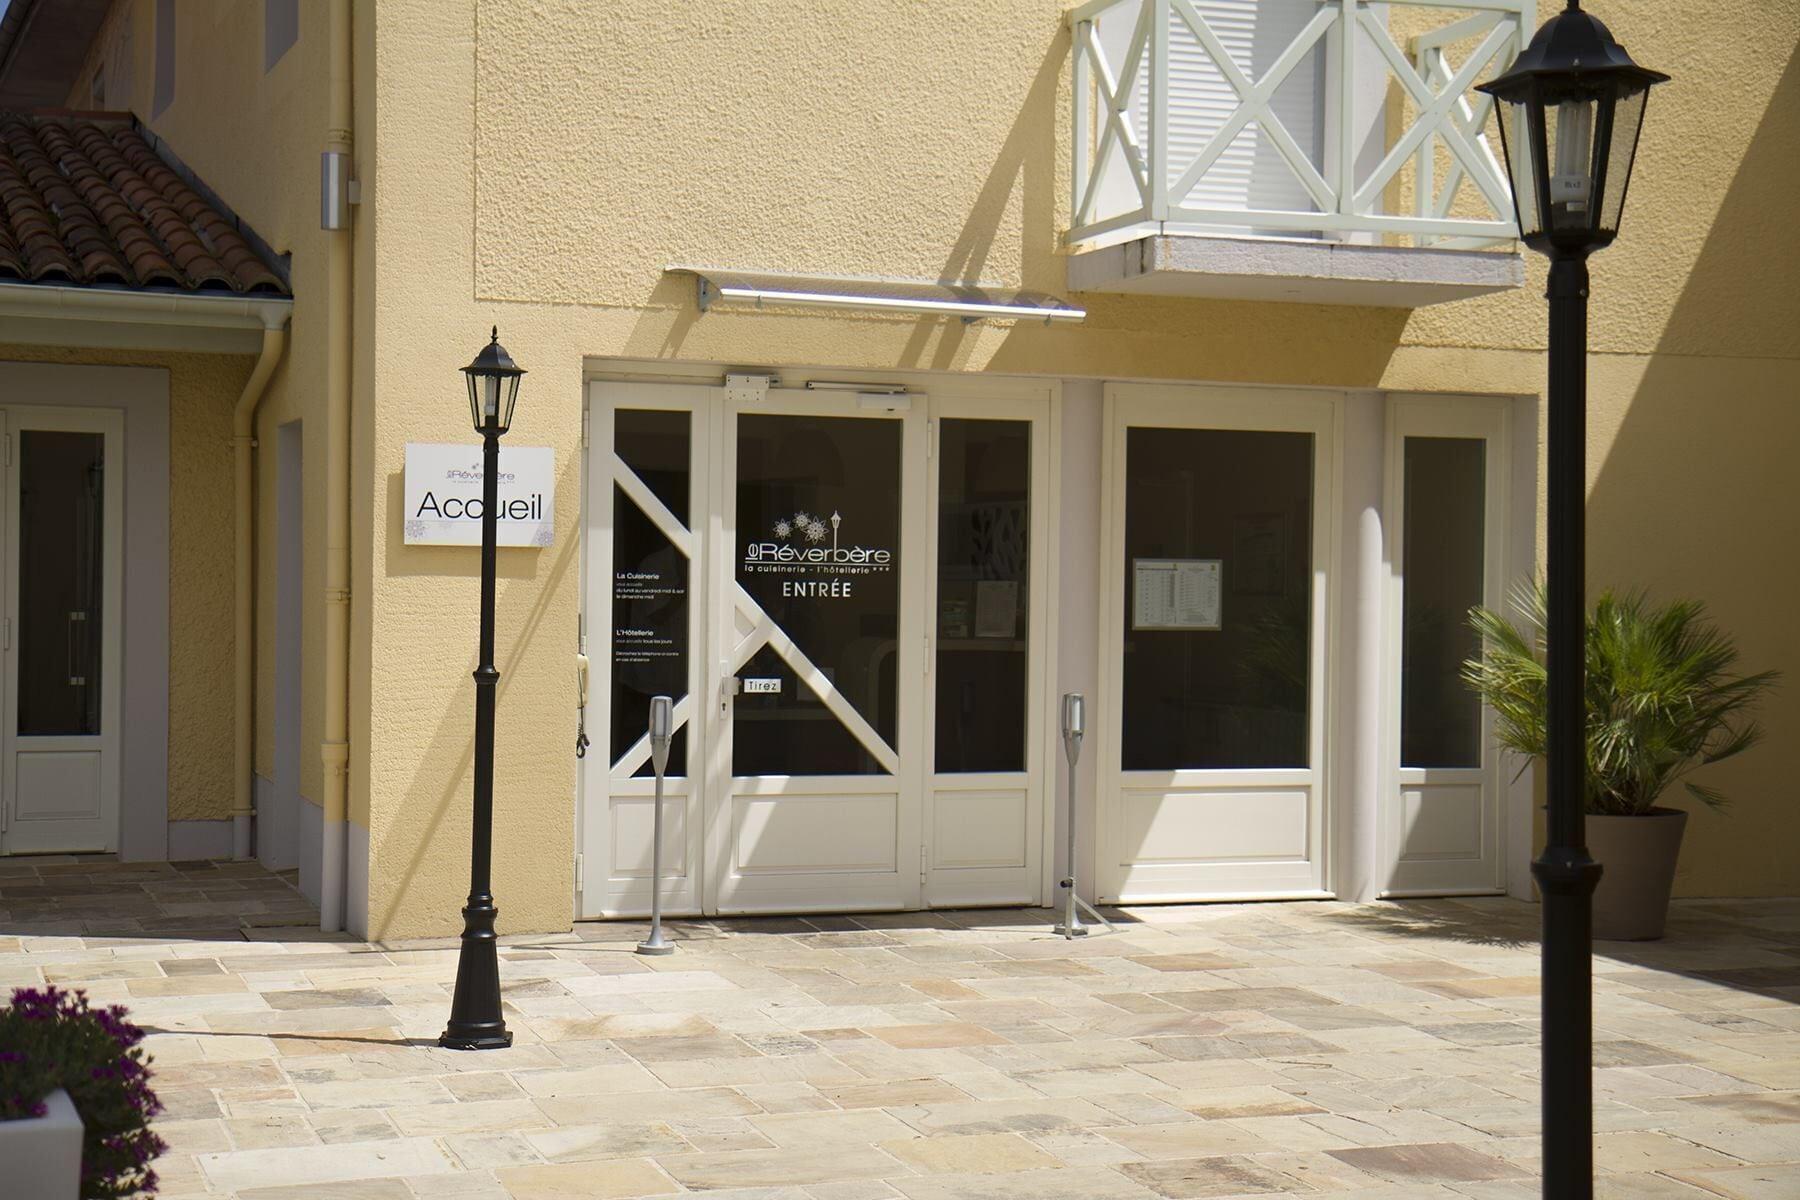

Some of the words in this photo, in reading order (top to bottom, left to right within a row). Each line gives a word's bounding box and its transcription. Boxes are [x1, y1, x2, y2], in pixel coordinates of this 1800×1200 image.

[451, 470, 516, 480] Réveère
[759, 543, 891, 563] Réverbère
[744, 564, 754, 573] la
[757, 565, 806, 574] cuisinerie
[626, 572, 660, 580] Cuisinerie
[783, 578, 852, 598] ENTRÉE
[616, 629, 654, 637] L'Hôtellerie
[748, 680, 777, 691] Tirez
